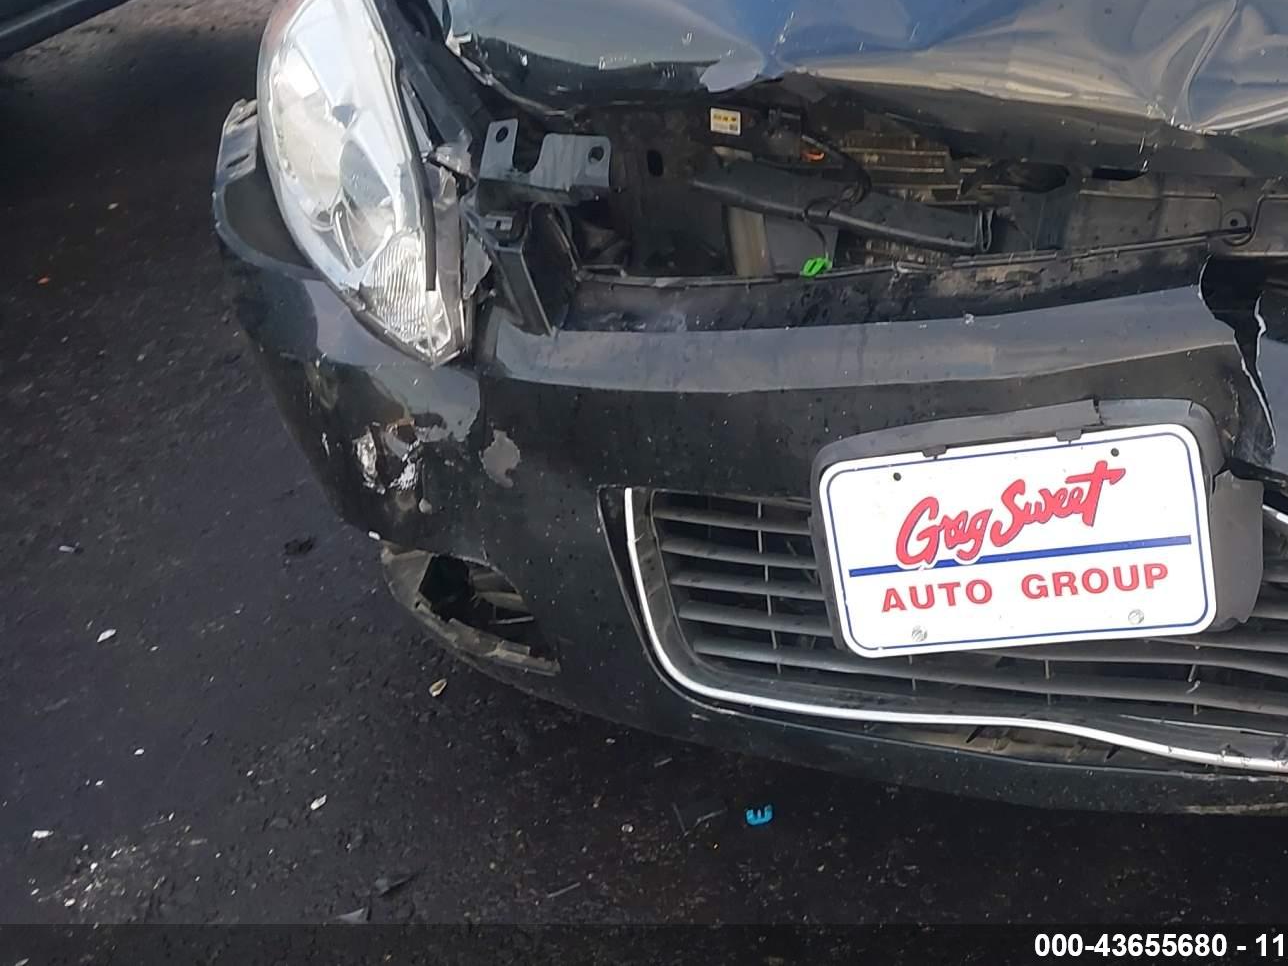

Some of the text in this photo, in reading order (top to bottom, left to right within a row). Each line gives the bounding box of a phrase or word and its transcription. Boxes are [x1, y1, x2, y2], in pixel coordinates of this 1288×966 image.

[895, 460, 1126, 566] Greg Sweet
[881, 563, 1169, 612] AUTO GROUP
